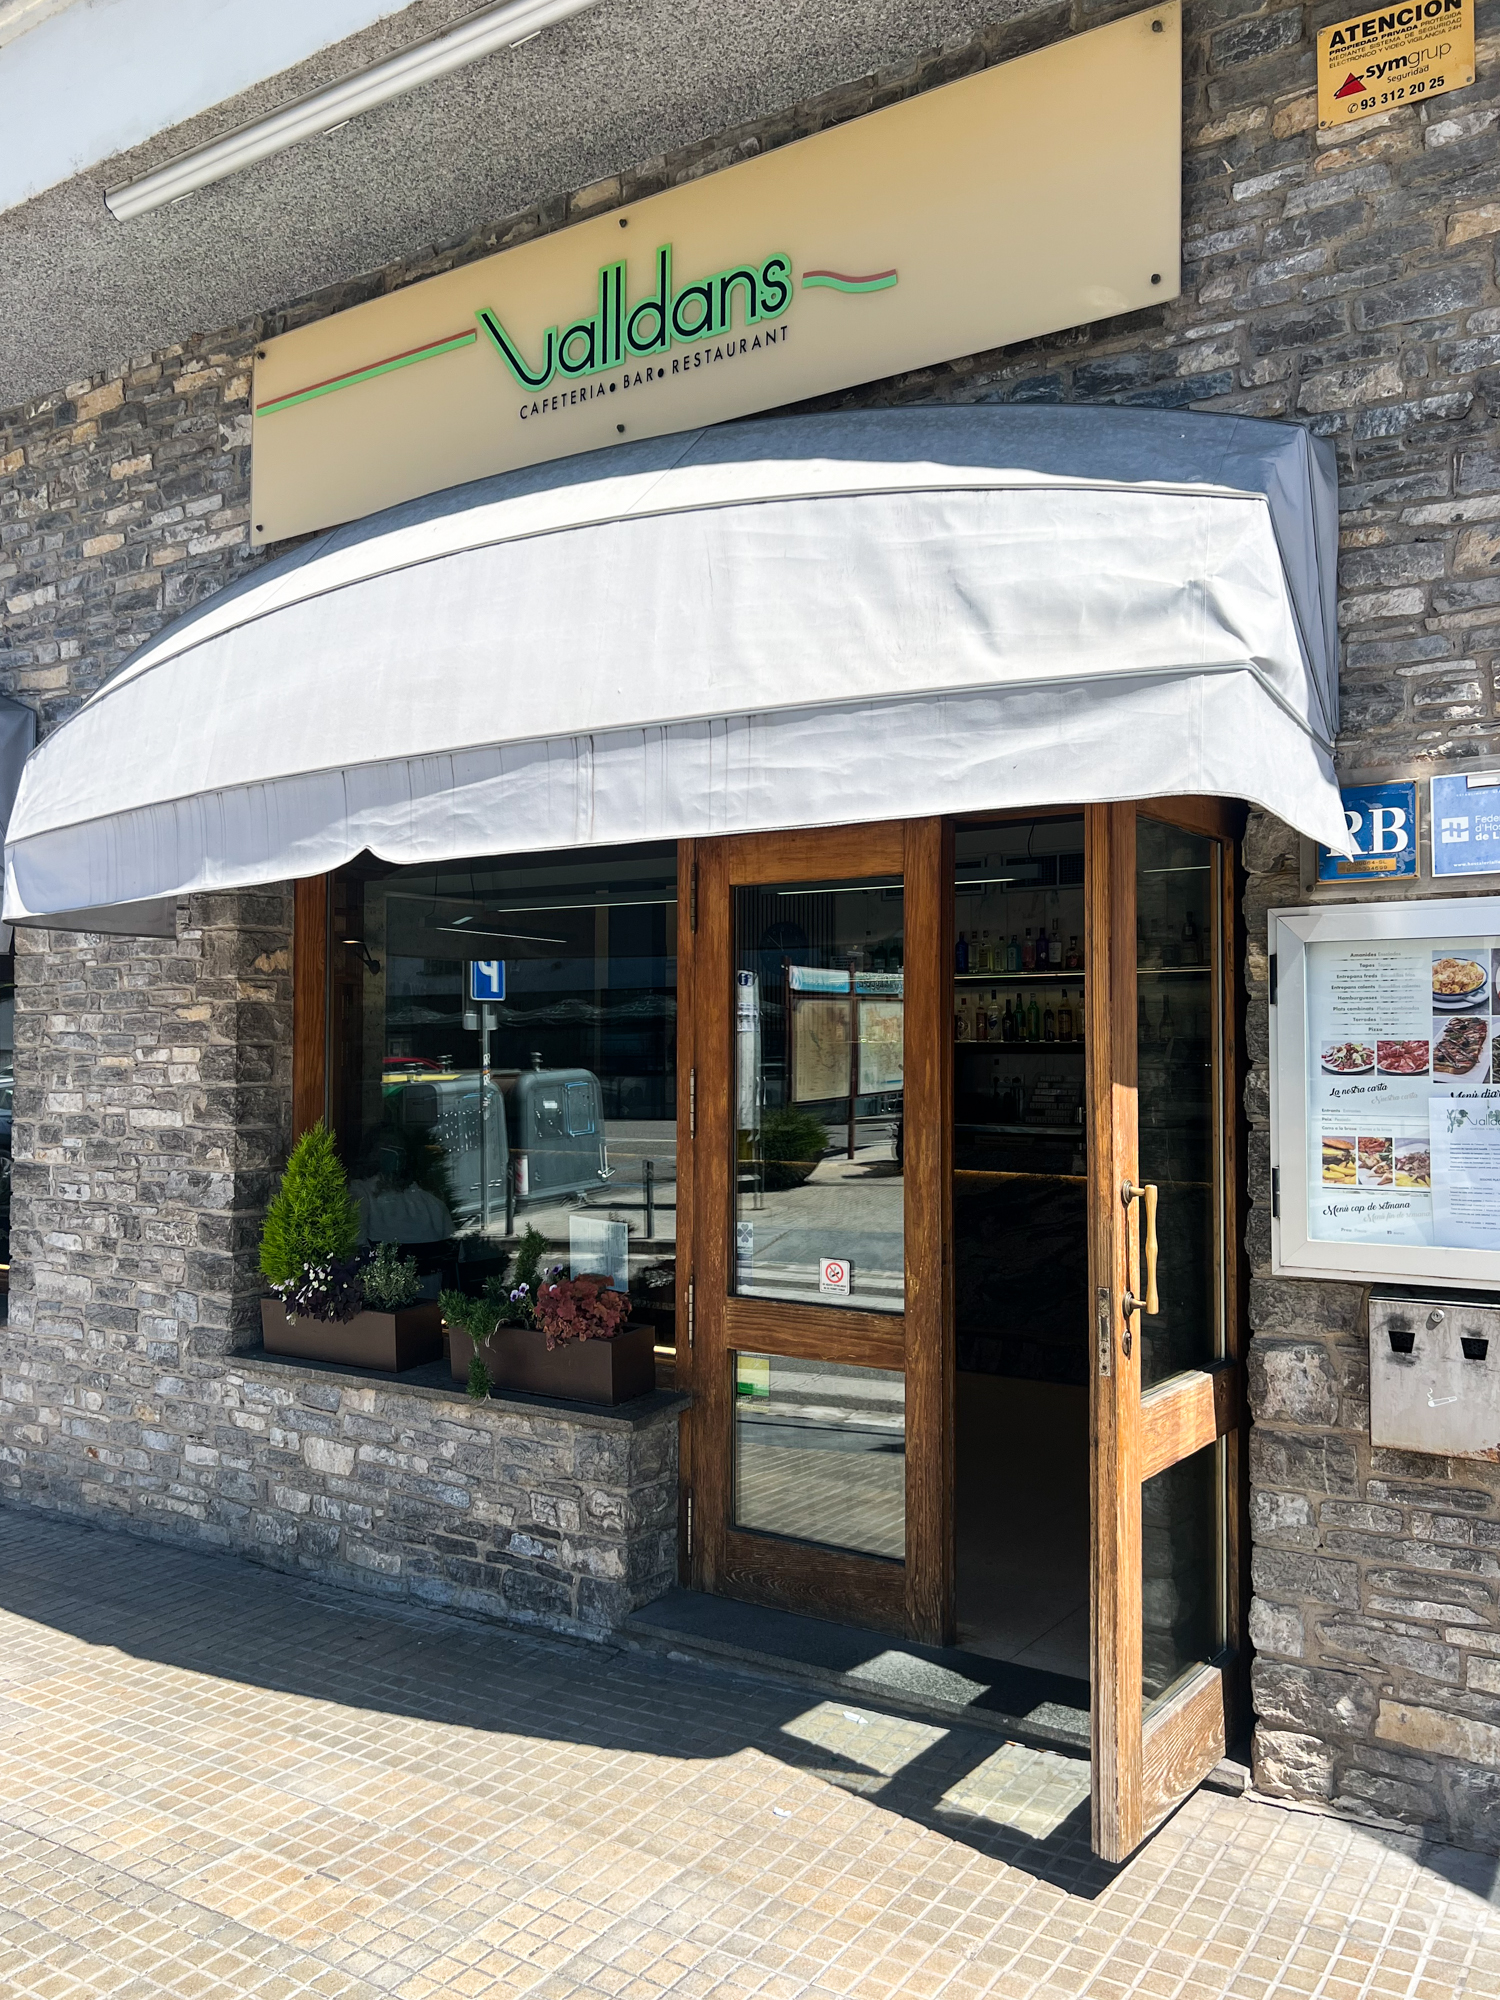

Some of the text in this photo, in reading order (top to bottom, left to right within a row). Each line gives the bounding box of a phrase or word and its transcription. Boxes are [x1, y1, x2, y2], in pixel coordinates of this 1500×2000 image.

[1329, 0, 1462, 48] ATENCION
[1329, 11, 1461, 56] PROPIEDAD PRIVADA PROTEGIDA
[1329, 17, 1461, 62] MEDIANTE SISTEMA DE SEGURIDAD
[1329, 51, 1377, 69] ELECTRONICO
[1384, 41, 1405, 52] VIDEO
[1407, 29, 1446, 45] VIGILANCIA
[1366, 42, 1452, 79] symgrup
[1387, 64, 1429, 83] Seguridad
[1360, 75, 1445, 111] 93 312 20 25
[519, 325, 788, 420] CAFETERIA BAR RESTAURANT
[1475, 832, 1490, 842] de
[1329, 1082, 1388, 1098] La nostra carta
[1370, 1092, 1418, 1104] Nuestra carta
[1322, 1201, 1410, 1217] Menú cap de setmana
[1386, 1212, 1395, 1221] fin
[1406, 1210, 1431, 1218] semana
